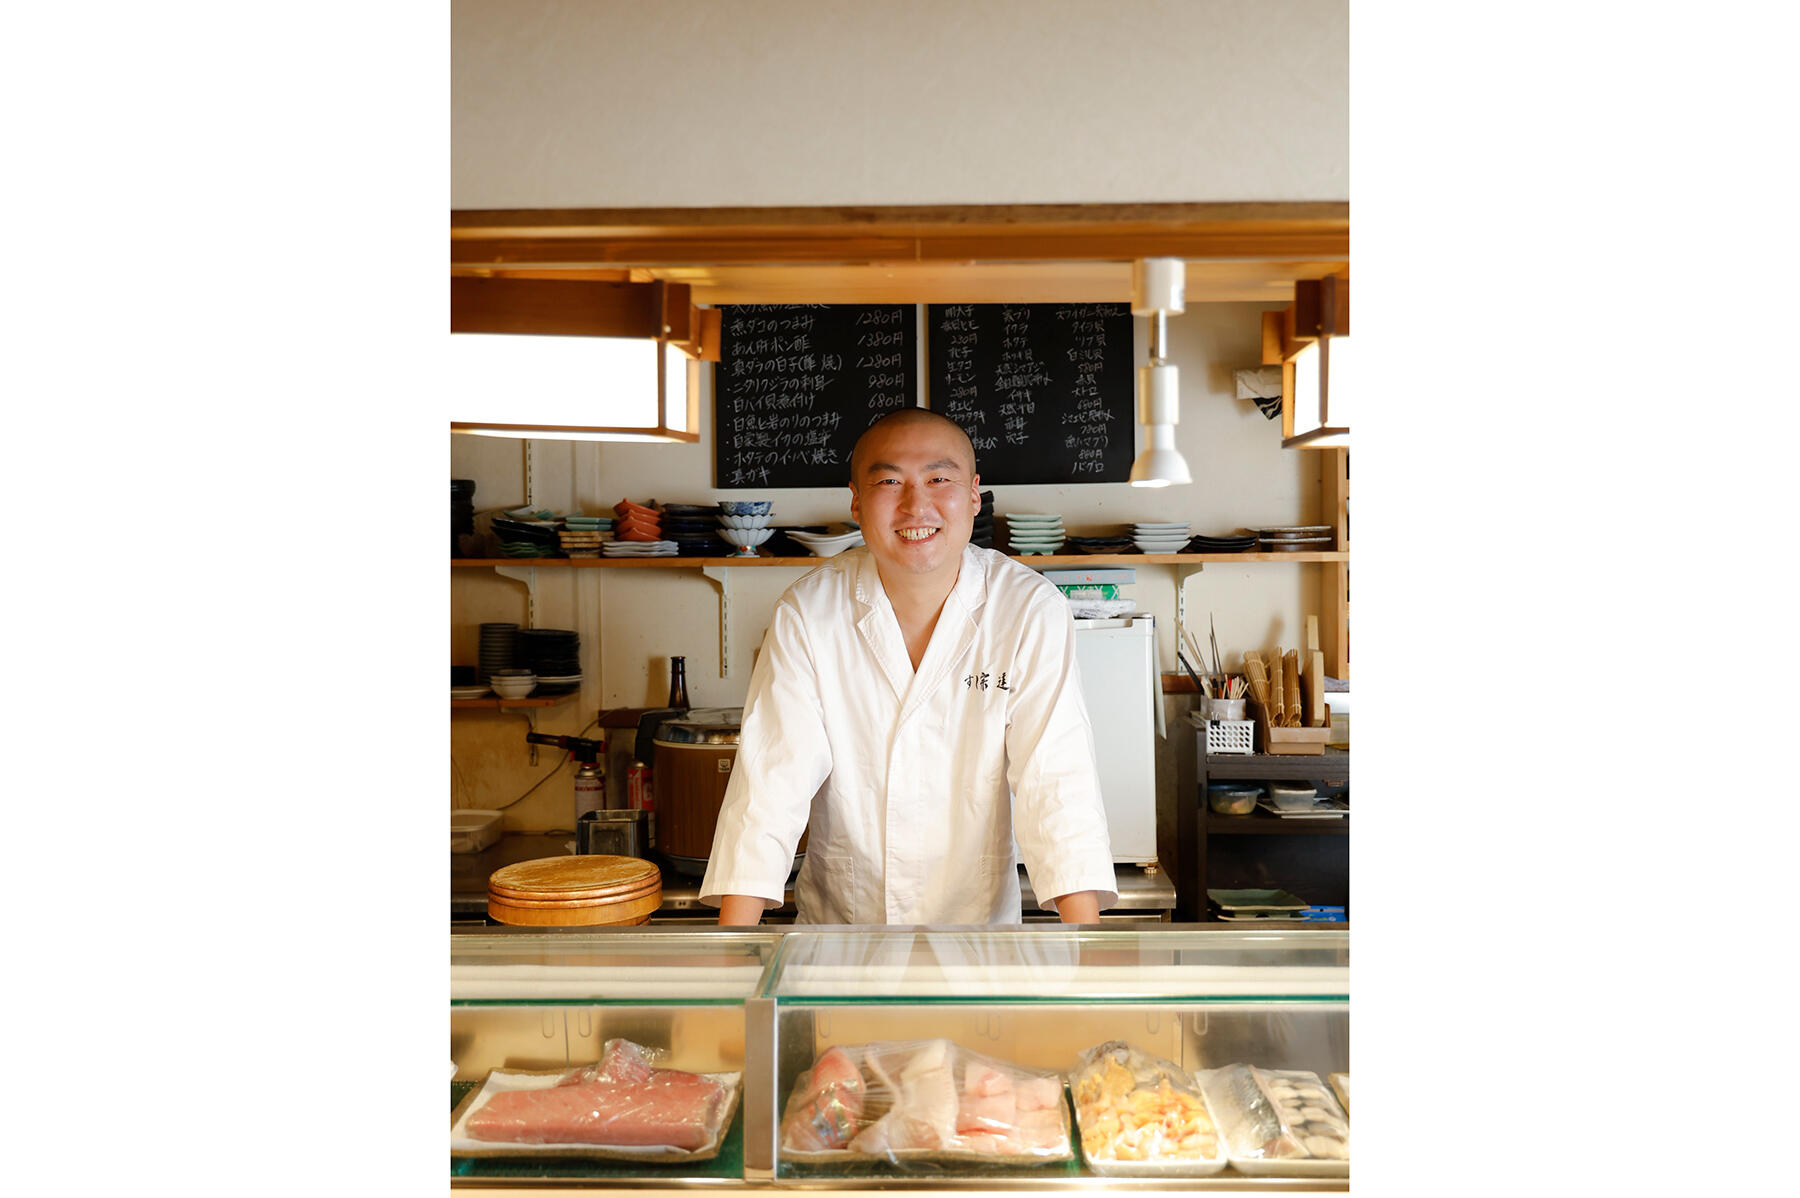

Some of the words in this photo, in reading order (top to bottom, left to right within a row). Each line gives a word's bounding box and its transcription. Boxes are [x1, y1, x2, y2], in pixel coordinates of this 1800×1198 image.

[856, 309, 903, 326] 1280円
[857, 331, 903, 345] 1380円
[856, 353, 902, 368] 1280円
[868, 372, 904, 389] 980円
[868, 393, 905, 409] 680円
